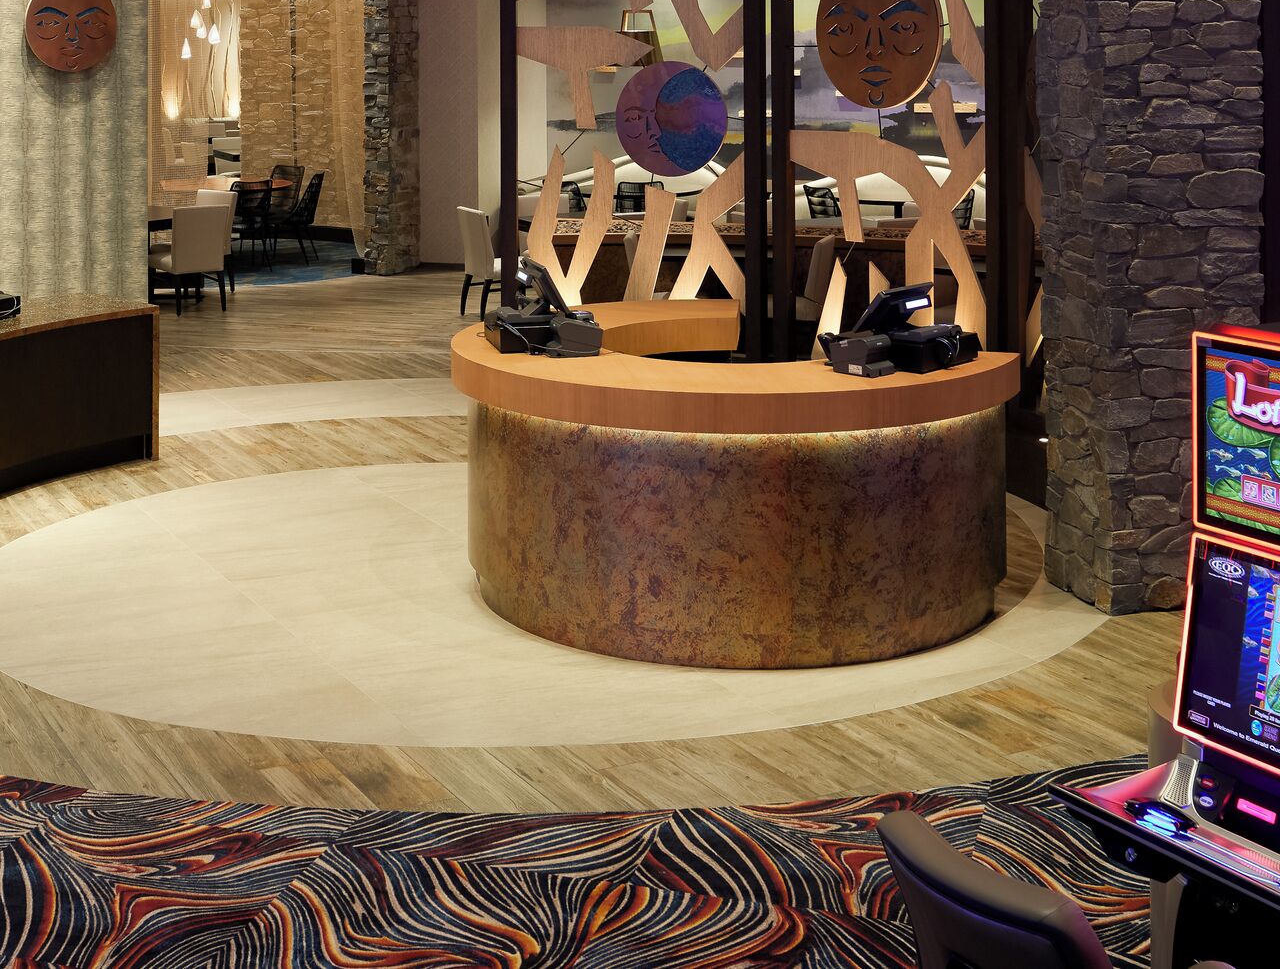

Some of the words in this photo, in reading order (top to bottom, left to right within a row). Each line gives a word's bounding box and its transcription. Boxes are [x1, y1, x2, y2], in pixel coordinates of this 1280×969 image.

[1214, 722, 1239, 737] Welcome
[1239, 732, 1245, 740] to
[1246, 734, 1269, 749] Emerald
